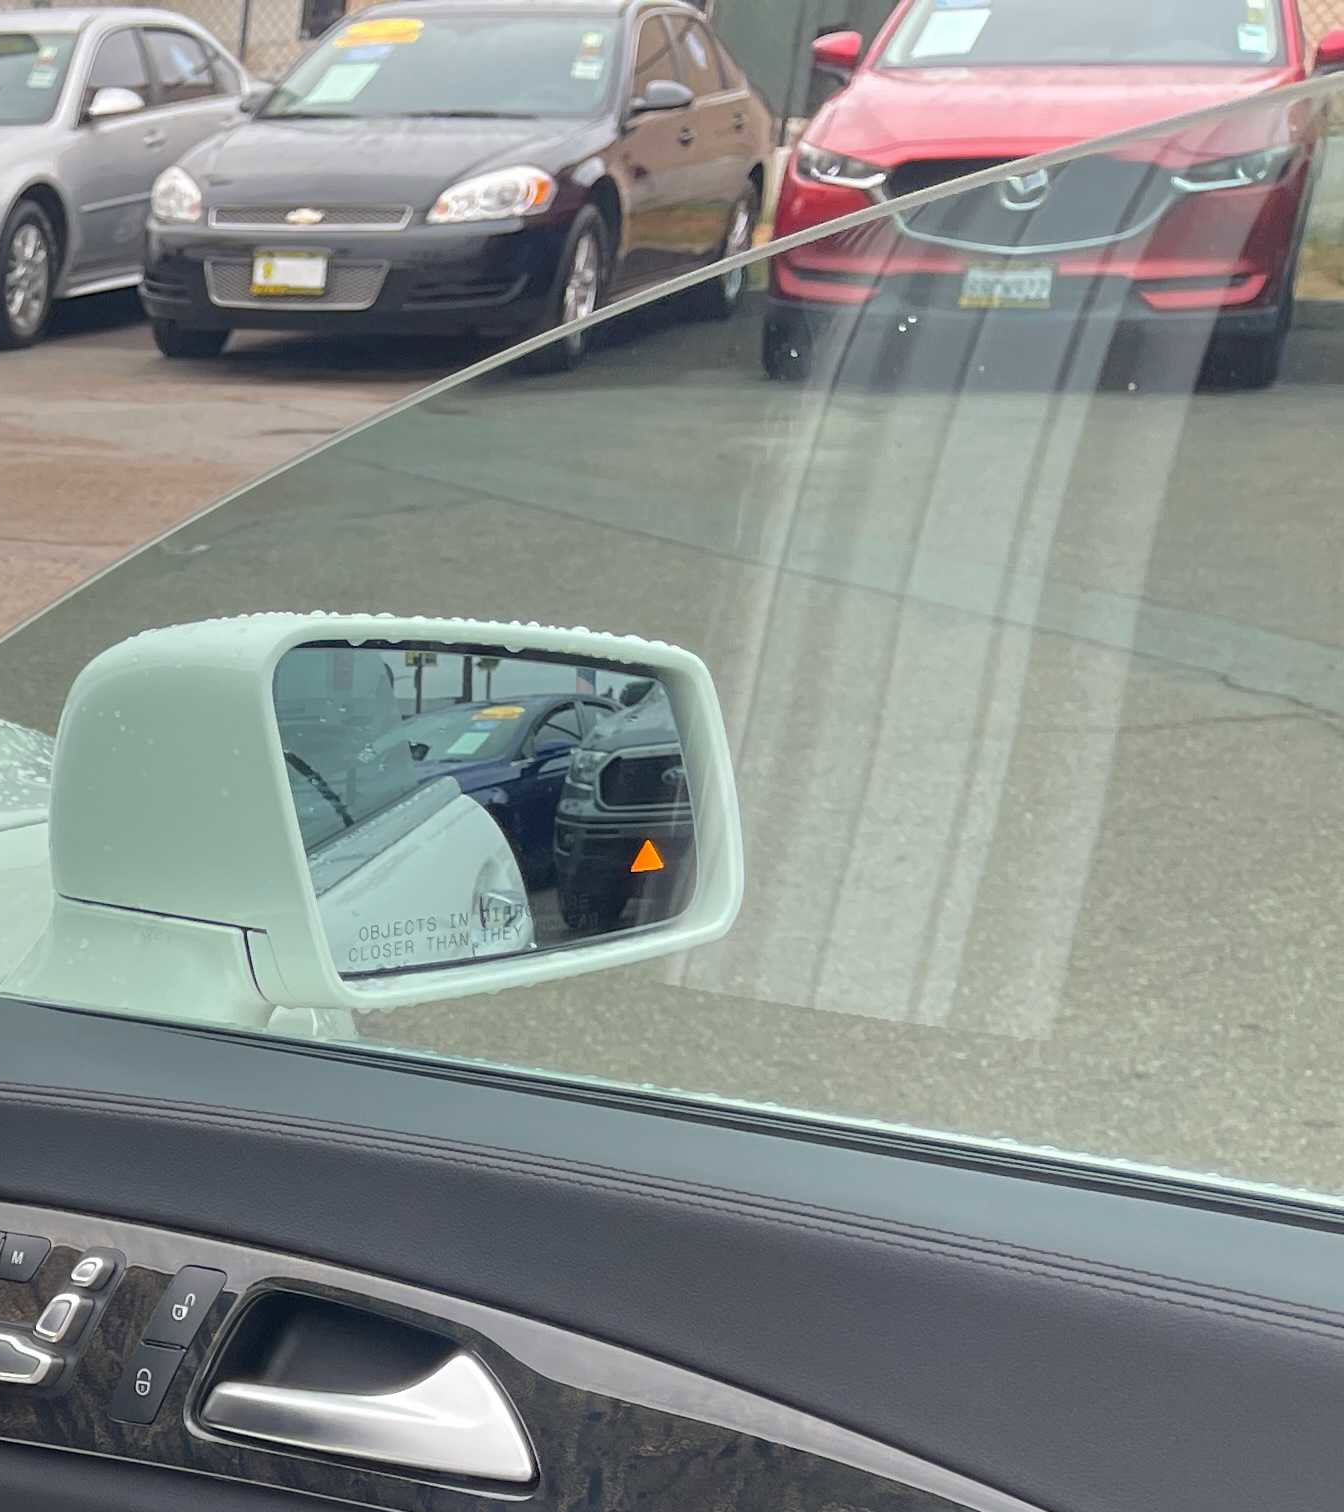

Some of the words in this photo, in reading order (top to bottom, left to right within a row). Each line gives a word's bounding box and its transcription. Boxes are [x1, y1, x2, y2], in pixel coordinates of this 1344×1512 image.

[358, 916, 438, 942] OBJECTS
[449, 912, 469, 928] IN
[348, 938, 415, 963] CLOSER
[426, 933, 470, 950] THAN
[480, 925, 522, 945] THEY
[10, 1250, 25, 1265] M
